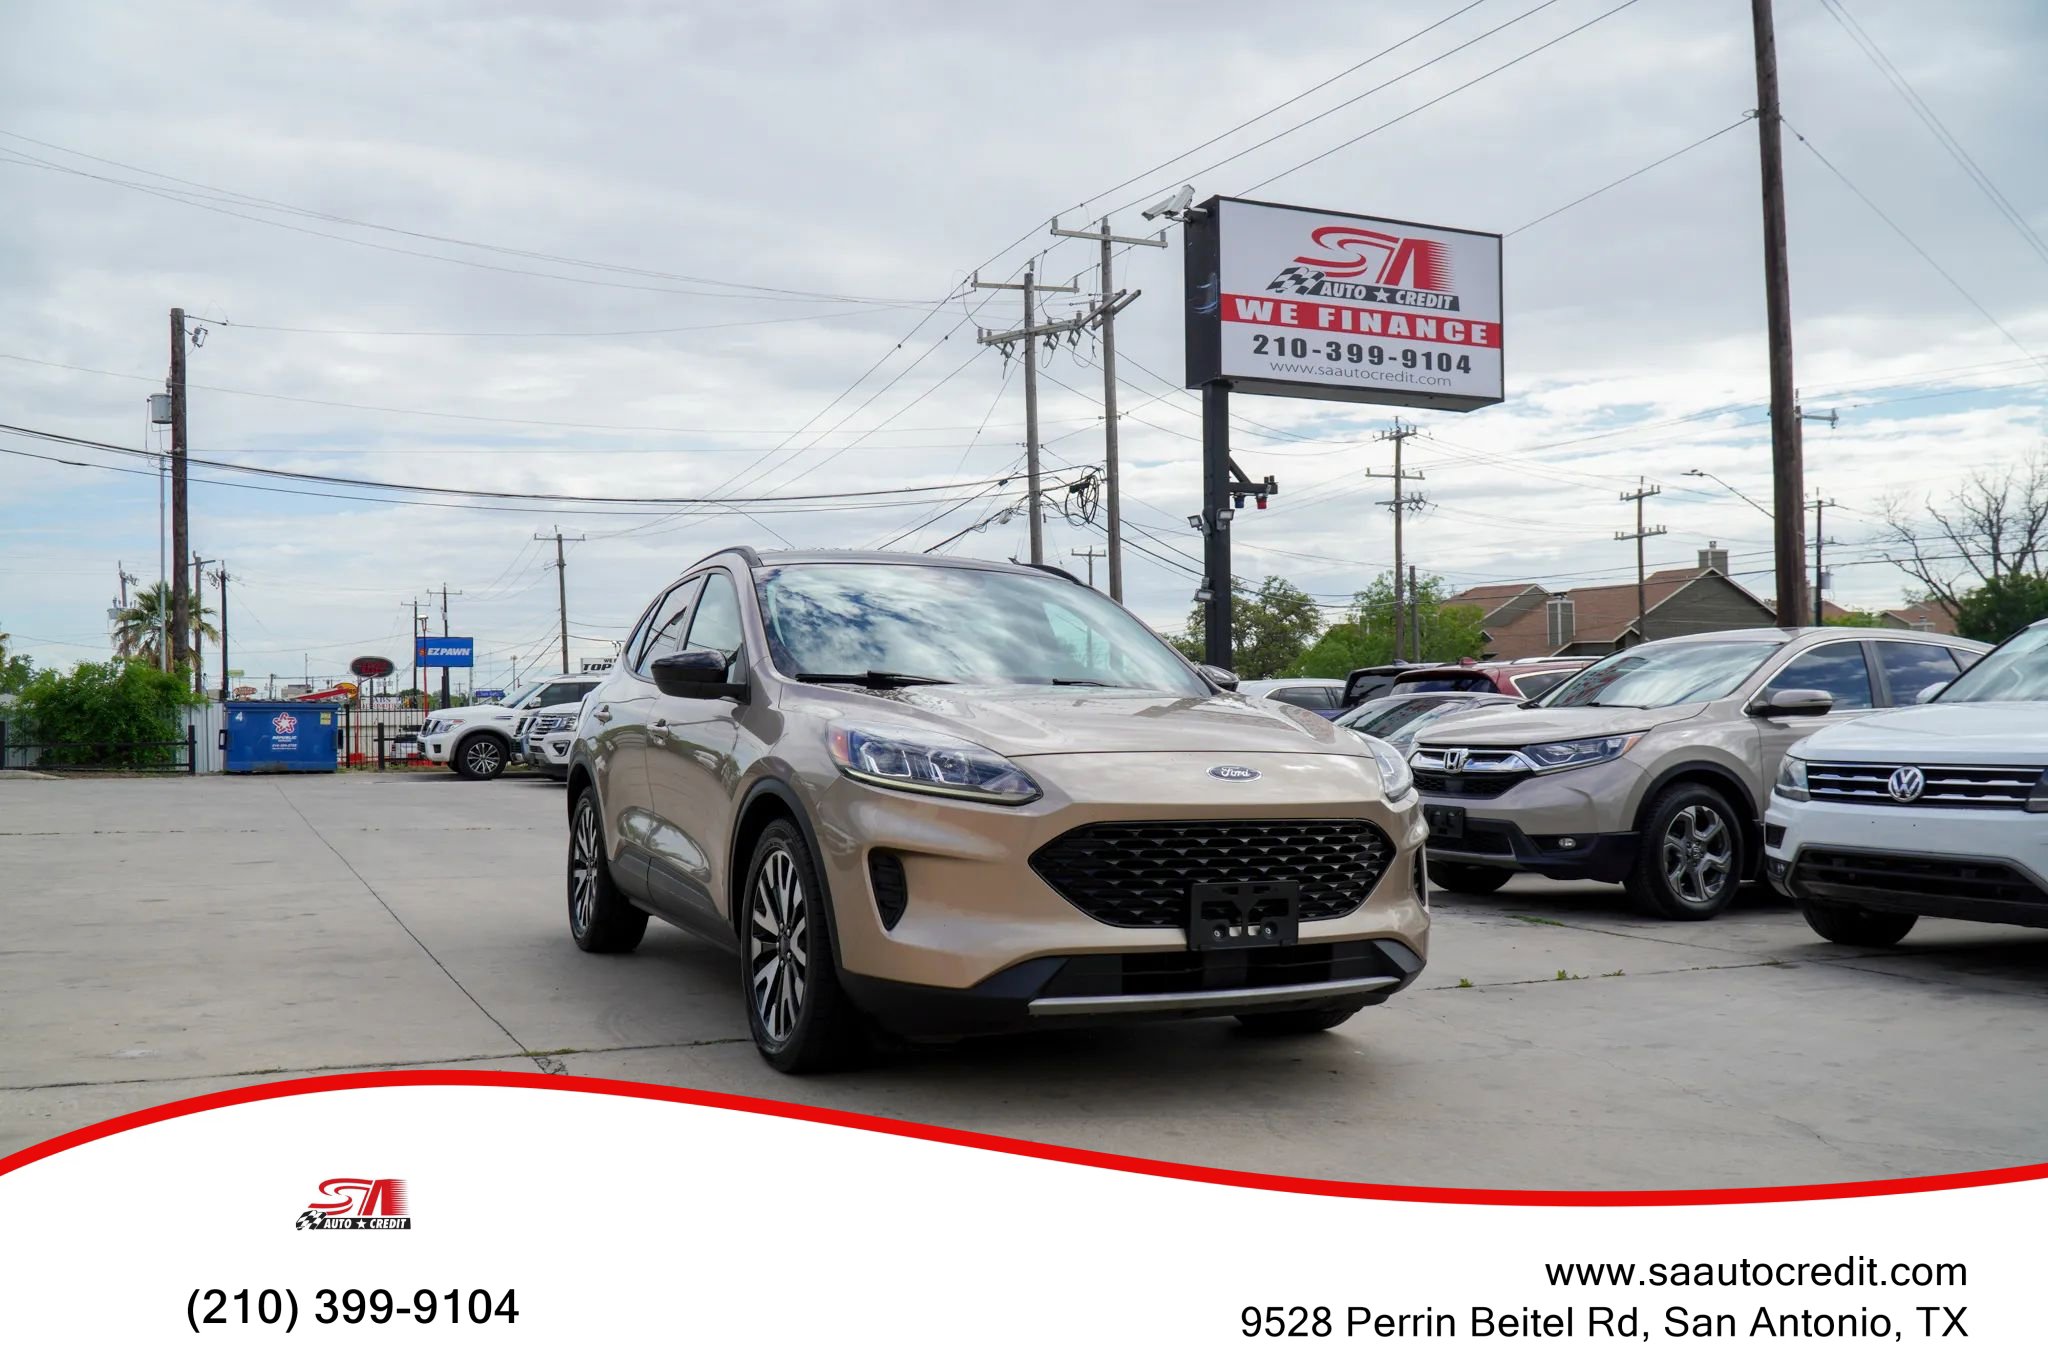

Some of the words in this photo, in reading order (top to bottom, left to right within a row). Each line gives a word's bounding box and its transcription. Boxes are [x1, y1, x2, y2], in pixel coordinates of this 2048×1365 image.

[1320, 281, 1367, 300] AUTO
[1395, 290, 1453, 310] CREDIT
[1235, 298, 1298, 325] WE
[1318, 307, 1488, 344] FINANCE
[1252, 334, 1472, 374] 210-399-9104
[1270, 361, 1452, 387] www.saautocredit.com
[235, 712, 243, 722] 4
[1221, 766, 1249, 777] Ford
